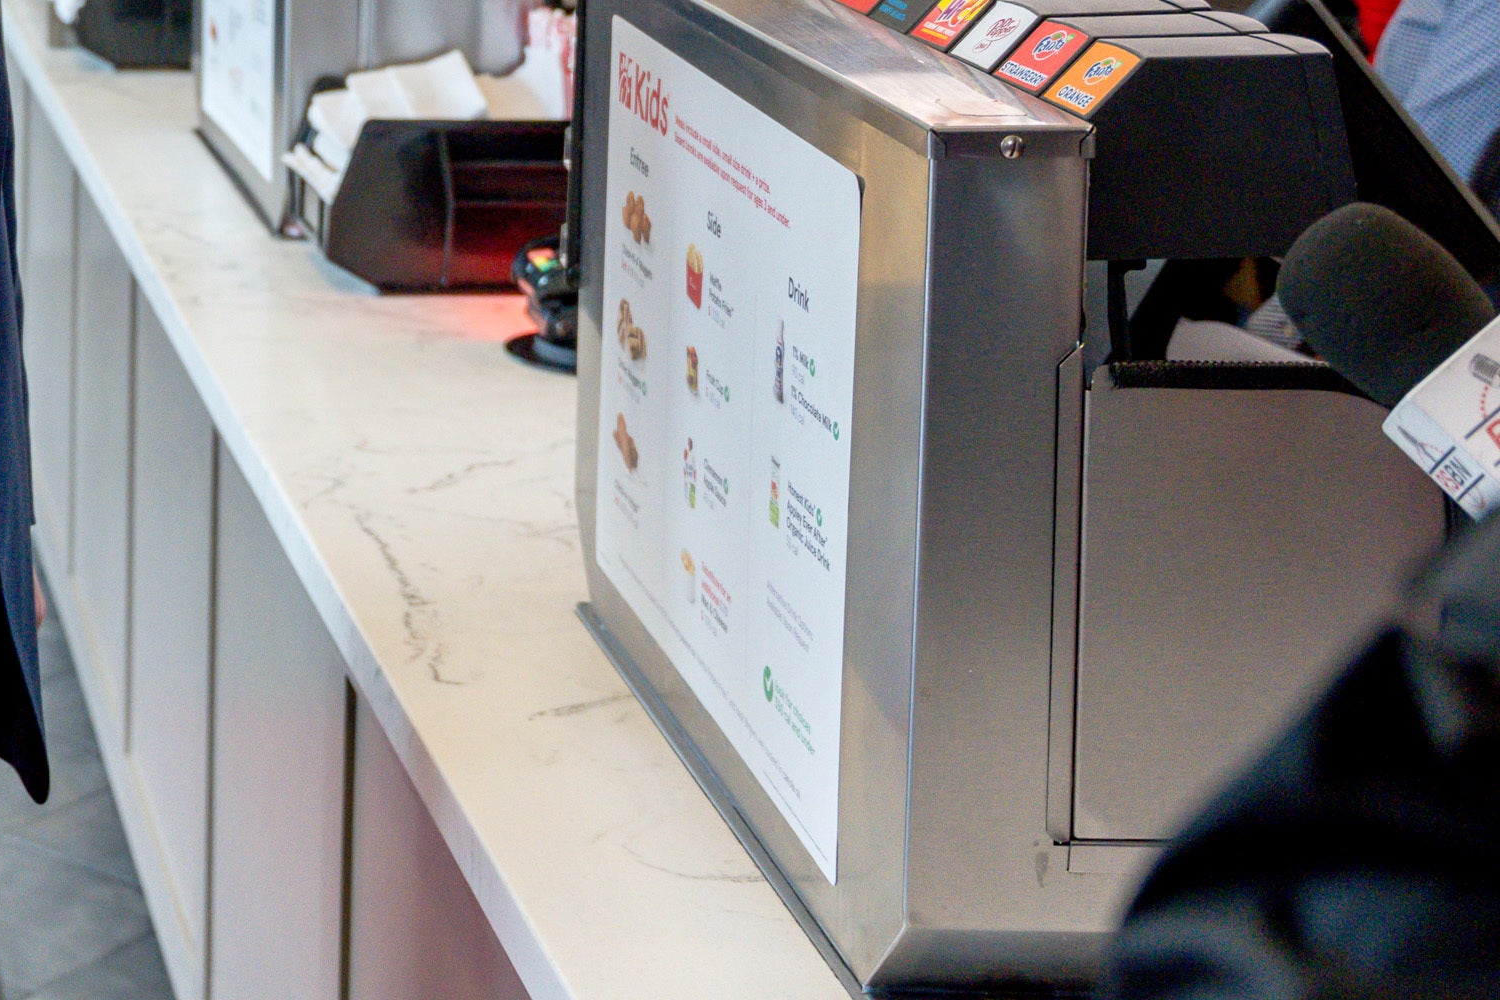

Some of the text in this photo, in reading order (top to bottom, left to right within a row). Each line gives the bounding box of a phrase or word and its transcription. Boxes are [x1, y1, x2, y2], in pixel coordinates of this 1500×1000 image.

[1033, 33, 1065, 57] Fanta
[1000, 61, 1048, 86] STRAWBERRY
[1084, 62, 1114, 82] Fanta
[634, 64, 669, 136] Kids
[1057, 85, 1094, 108] ORANGE
[630, 147, 649, 177] Entree
[707, 211, 721, 238] Side
[788, 277, 809, 312] Drink
[797, 391, 822, 422] Chocolate
